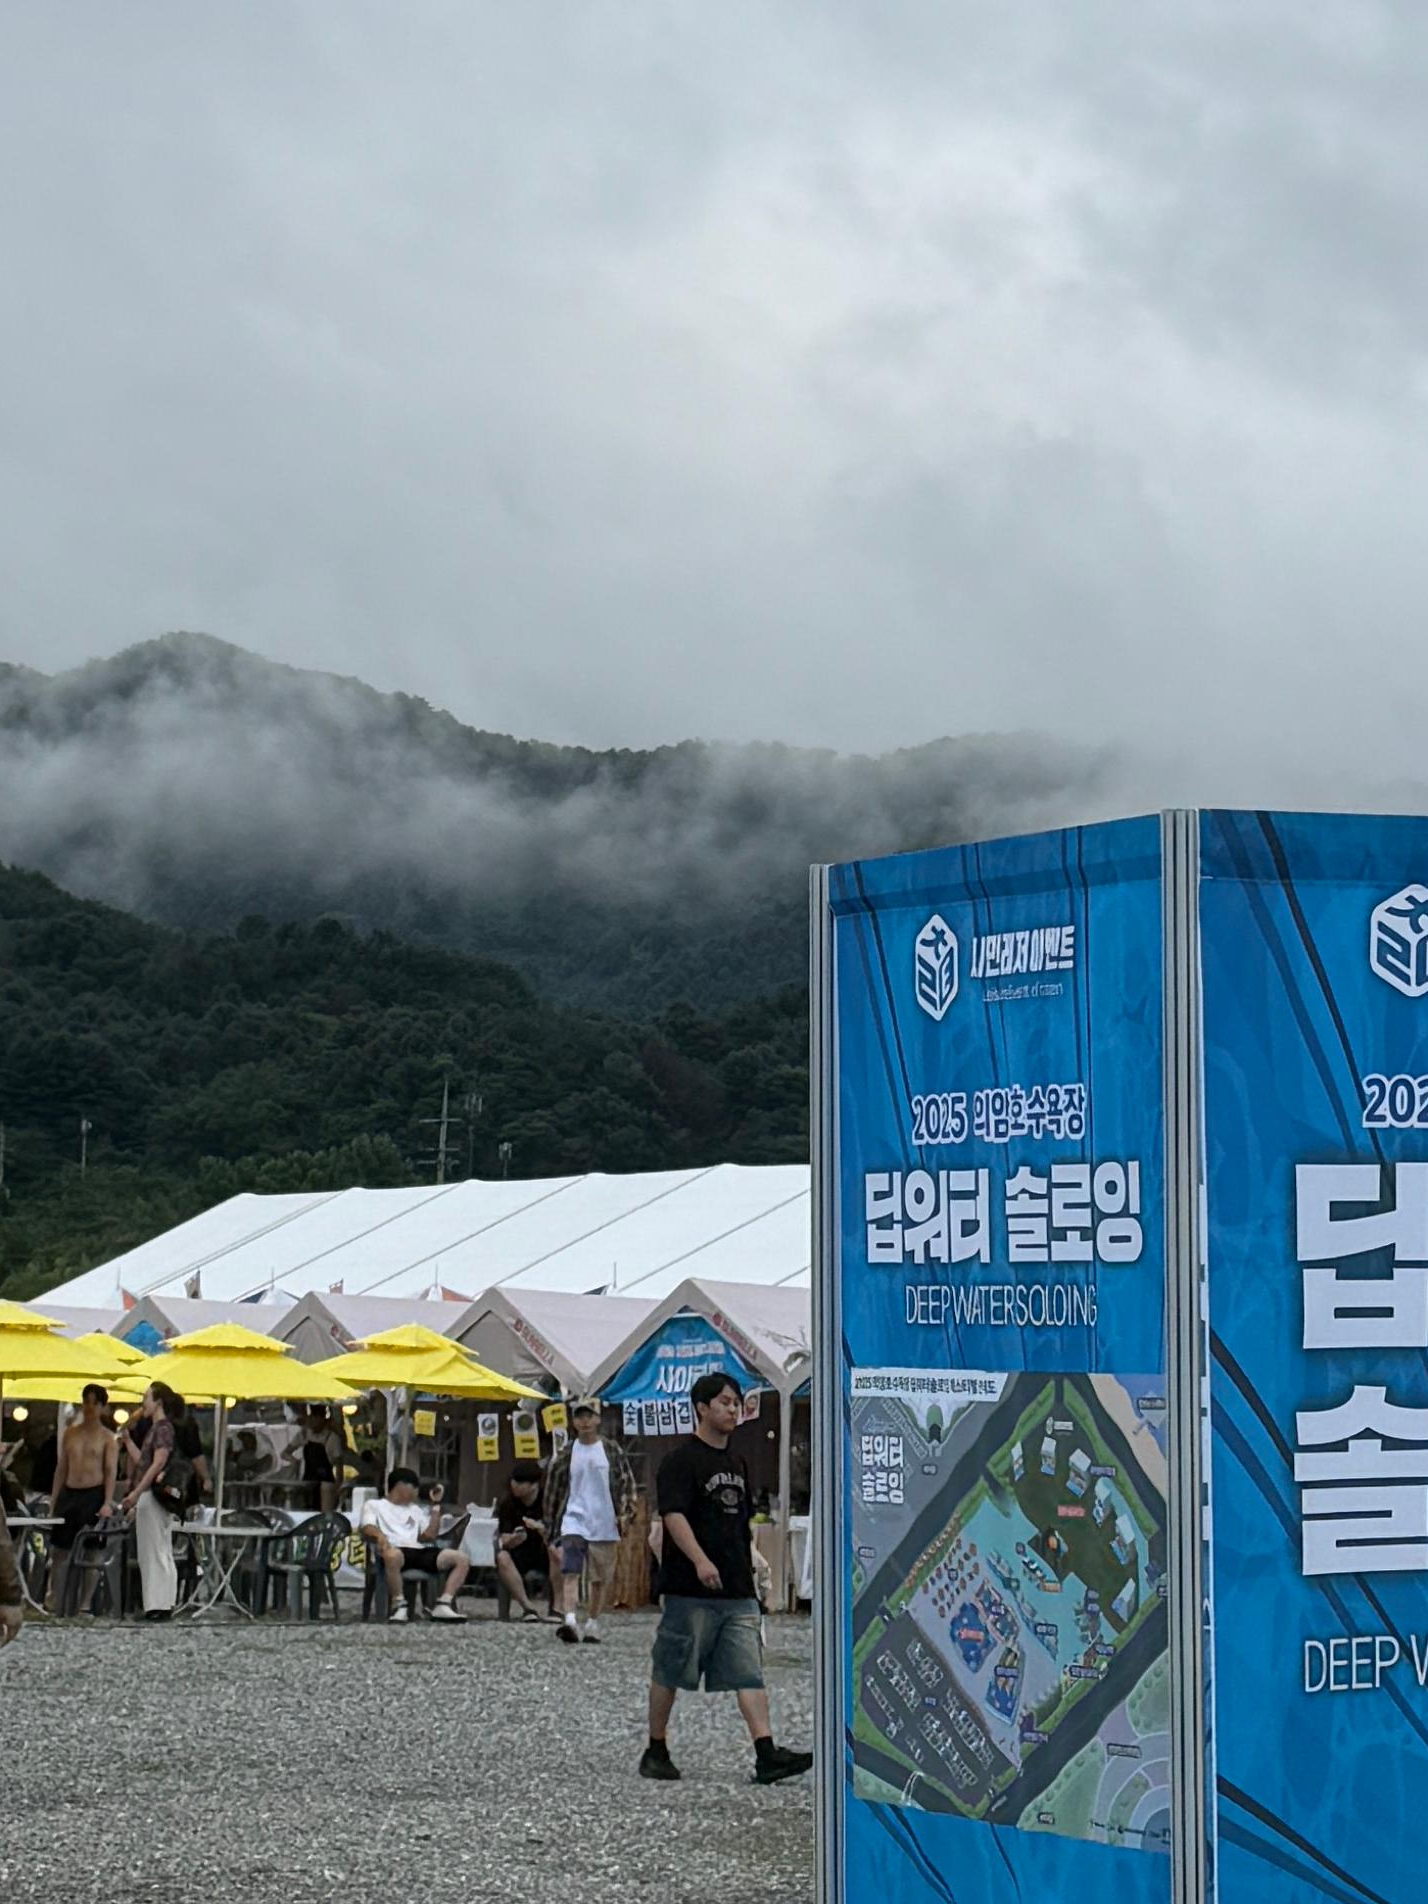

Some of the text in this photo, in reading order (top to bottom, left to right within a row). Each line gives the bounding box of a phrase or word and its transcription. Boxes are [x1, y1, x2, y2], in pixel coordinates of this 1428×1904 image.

[970, 925, 1075, 978] 시민레저이벤트
[912, 1083, 1086, 1145] 2025 의암호수욕장
[865, 1160, 1143, 1264] 딥워터 솔로잉
[905, 1284, 1098, 1327] DEEP WATER SOLOING
[1304, 1635, 1400, 1693] DEEP
